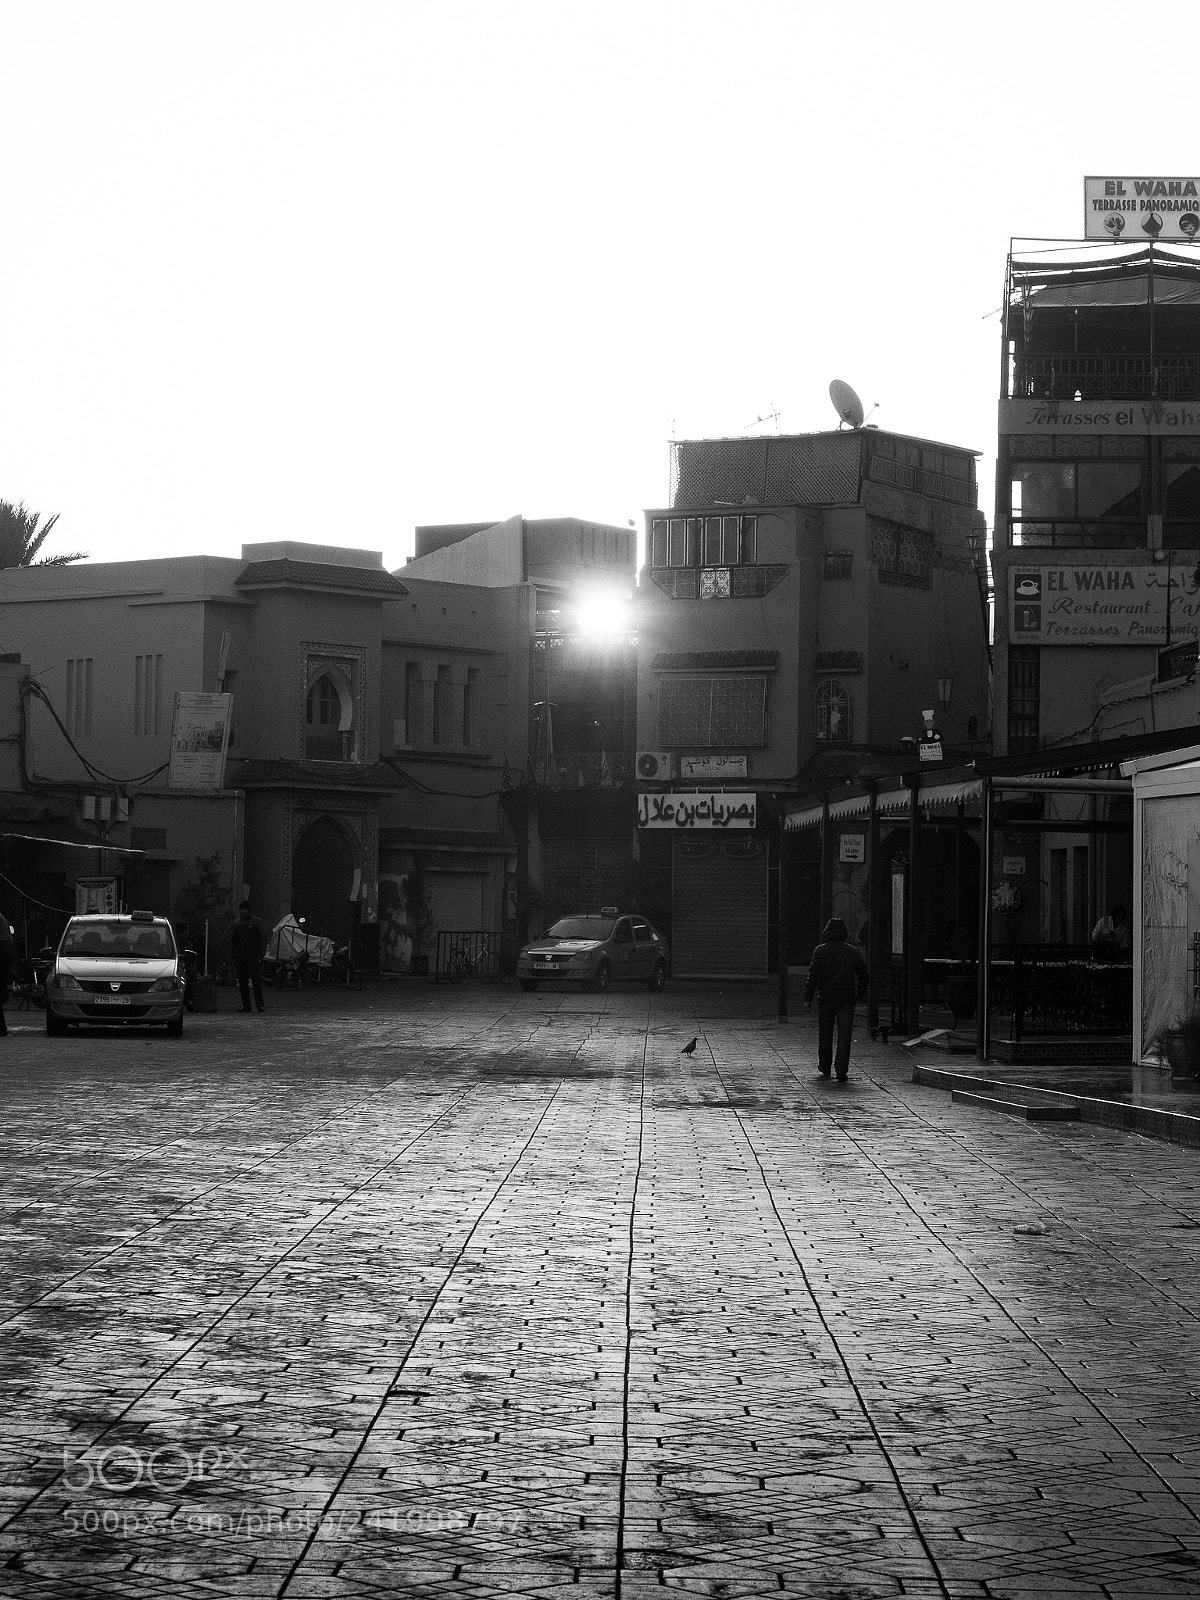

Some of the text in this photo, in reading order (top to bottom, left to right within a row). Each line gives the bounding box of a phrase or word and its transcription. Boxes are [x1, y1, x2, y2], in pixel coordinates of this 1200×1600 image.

[1104, 180, 1198, 197] EL WAHA
[1092, 199, 1136, 211] TERRASSE
[1026, 406, 1200, 426] Terrasses el Wah
[1047, 570, 1135, 591] EL WAHA
[1048, 596, 1152, 615] Restaurant
[1046, 621, 1120, 636] Terrasses
[638, 795, 755, 827] بصريات بن علال
